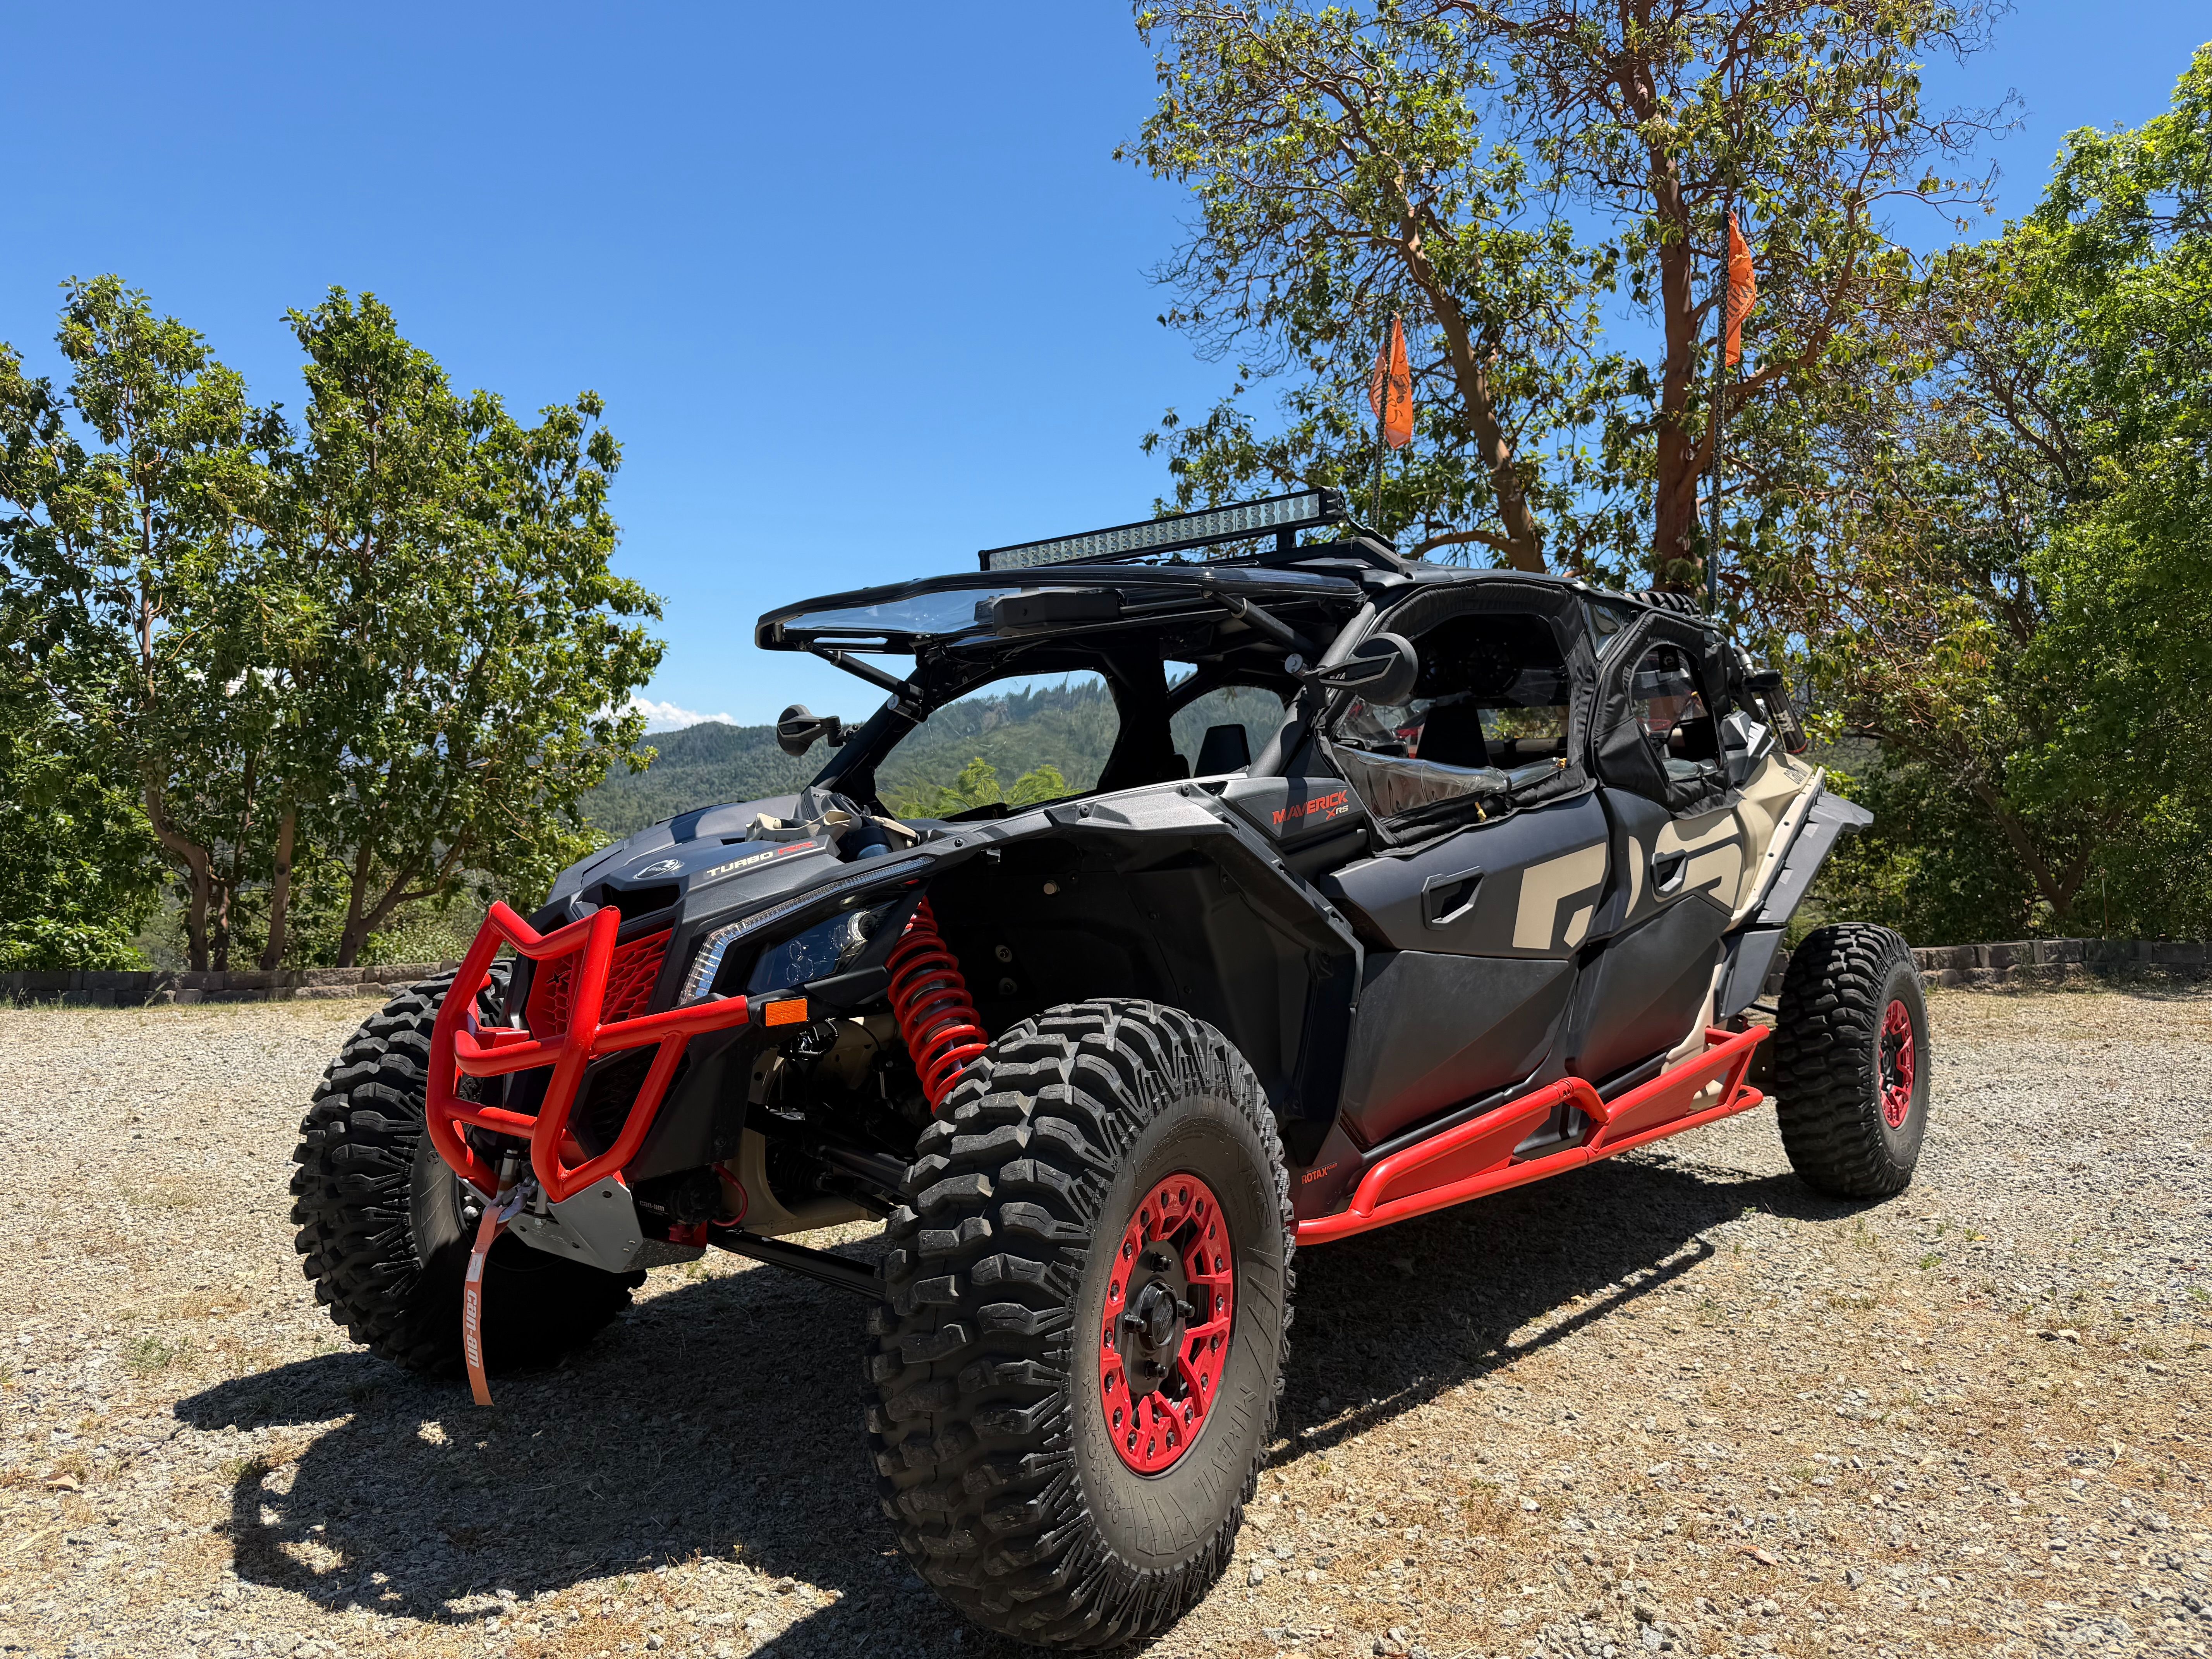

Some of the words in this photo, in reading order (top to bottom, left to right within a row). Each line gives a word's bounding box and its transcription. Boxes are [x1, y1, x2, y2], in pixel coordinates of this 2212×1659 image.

[1272, 790, 1348, 825] MAVERICK
[706, 851, 774, 877] TURBO
[778, 842, 815, 855] RR
[1301, 1166, 1328, 1184] ROTAX
[639, 1200, 665, 1212] can-am
[466, 1289, 479, 1368] can-am
